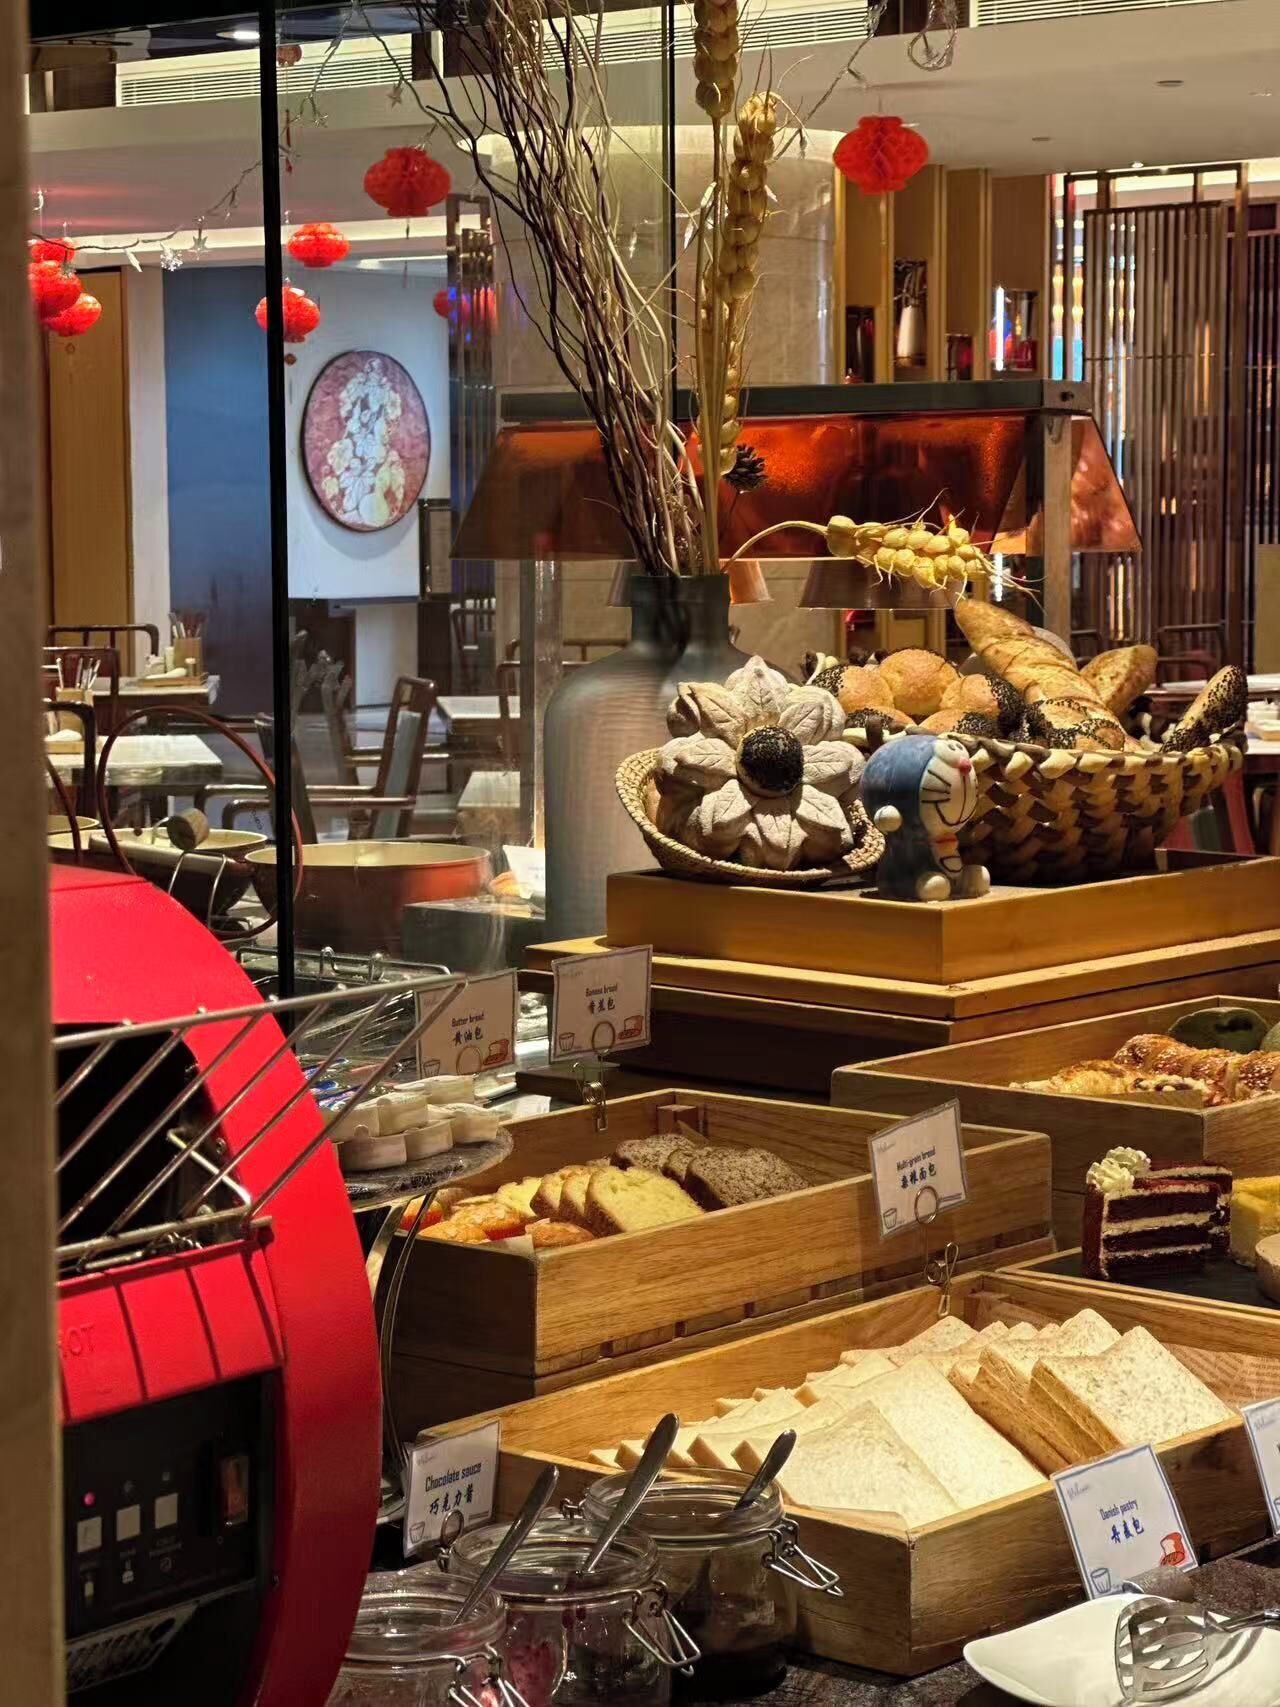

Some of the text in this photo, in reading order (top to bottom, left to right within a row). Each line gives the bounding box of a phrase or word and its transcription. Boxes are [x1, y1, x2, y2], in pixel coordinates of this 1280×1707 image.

[921, 1145, 936, 1160] bread
[425, 1462, 482, 1492] Chocolate sauce
[1100, 1499, 1139, 1521] Danish pastry
